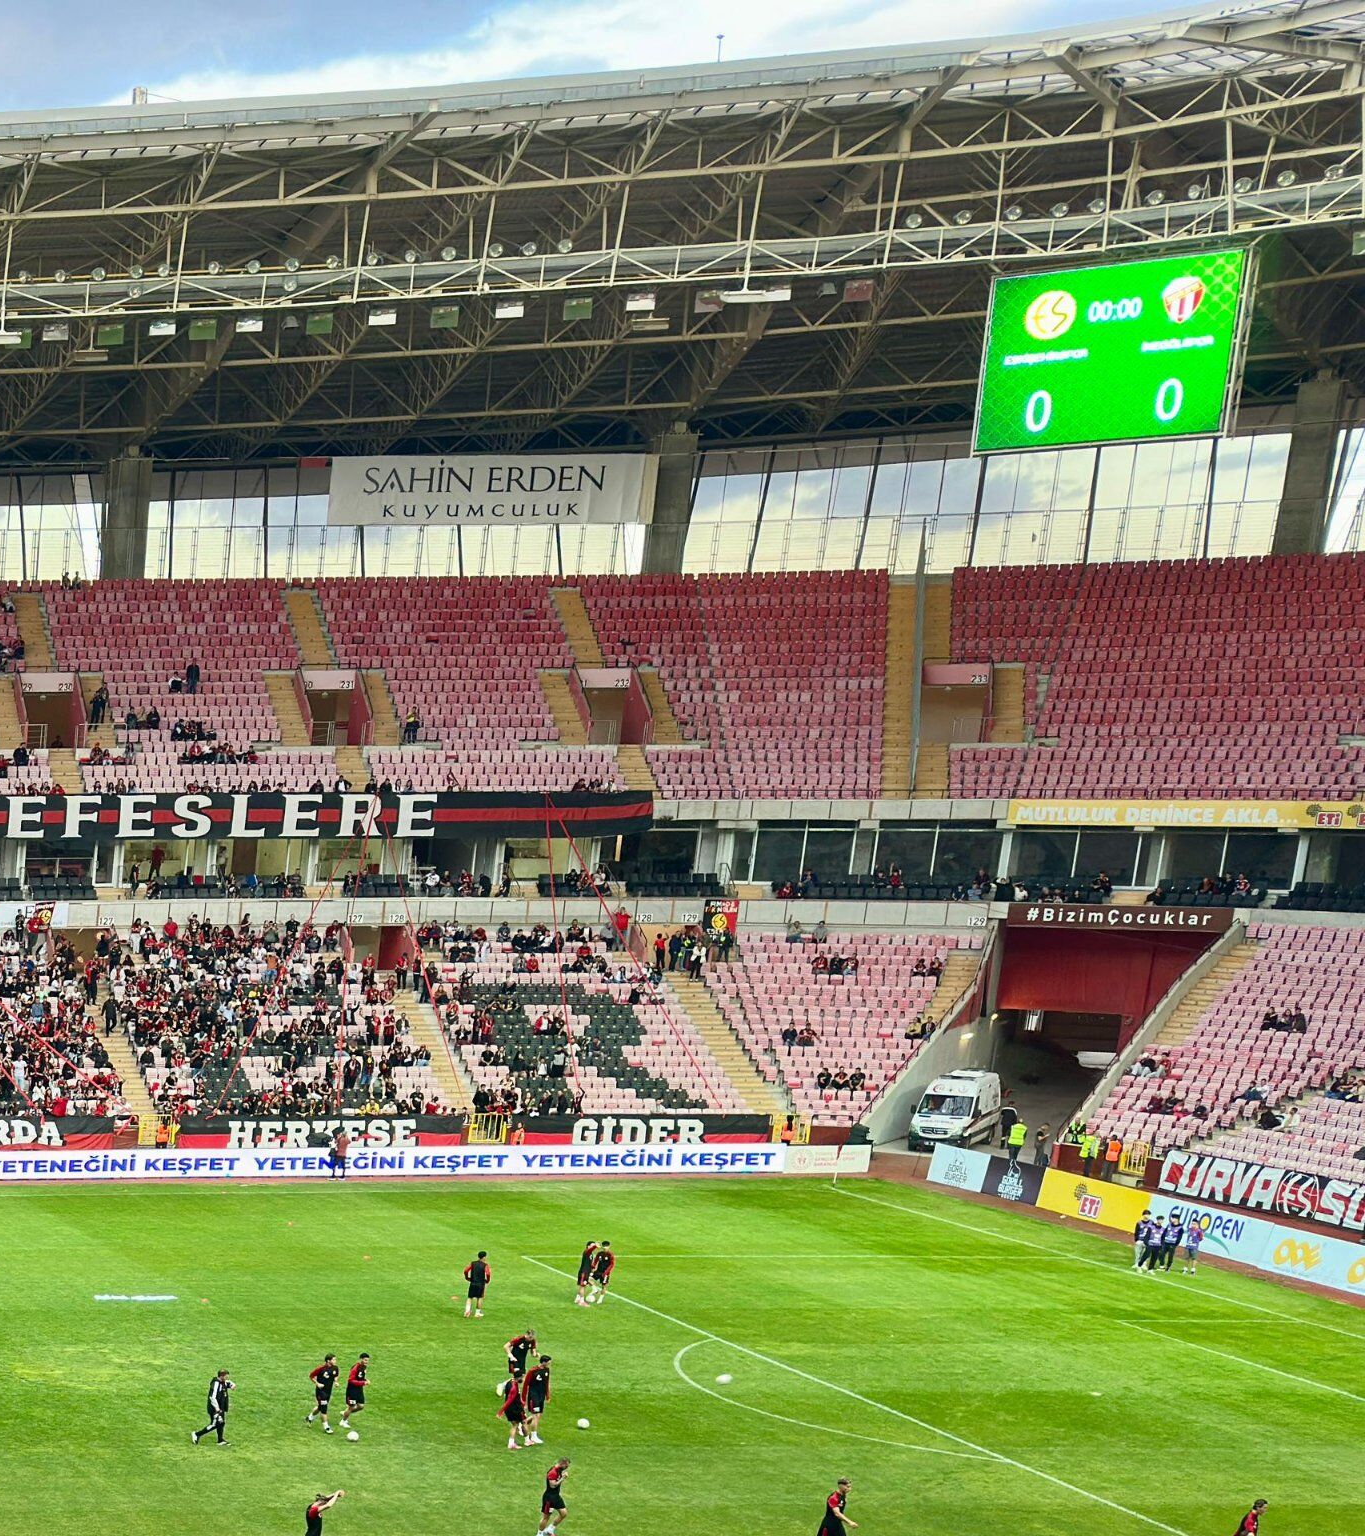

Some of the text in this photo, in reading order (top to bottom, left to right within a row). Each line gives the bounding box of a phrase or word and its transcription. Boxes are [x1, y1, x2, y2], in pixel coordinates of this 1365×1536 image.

[1088, 297, 1143, 323] 00:00
[1155, 378, 1184, 421] 0
[1025, 390, 1052, 433] 0
[486, 465, 607, 493] ERDEN
[383, 503, 580, 519] KUYUMCULUK
[1016, 806, 1117, 823] MUTLULUK
[1125, 803, 1214, 824] DENİNCE
[99, 917, 113, 925] 127
[348, 914, 363, 923] 127
[389, 914, 404, 923] 128
[637, 914, 652, 922] 128
[682, 914, 697, 922] 129
[968, 917, 985, 926] 129
[1026, 908, 1213, 926] #BizimÇocuklar
[572, 1116, 706, 1145] GİDER
[144, 1156, 238, 1175] KEŞFET
[413, 1153, 509, 1173] KEŞFET
[522, 1148, 674, 1168] YETENEĞİNİ
[680, 1150, 775, 1169] KEŞFET
[1158, 1150, 1287, 1210] CURVA
